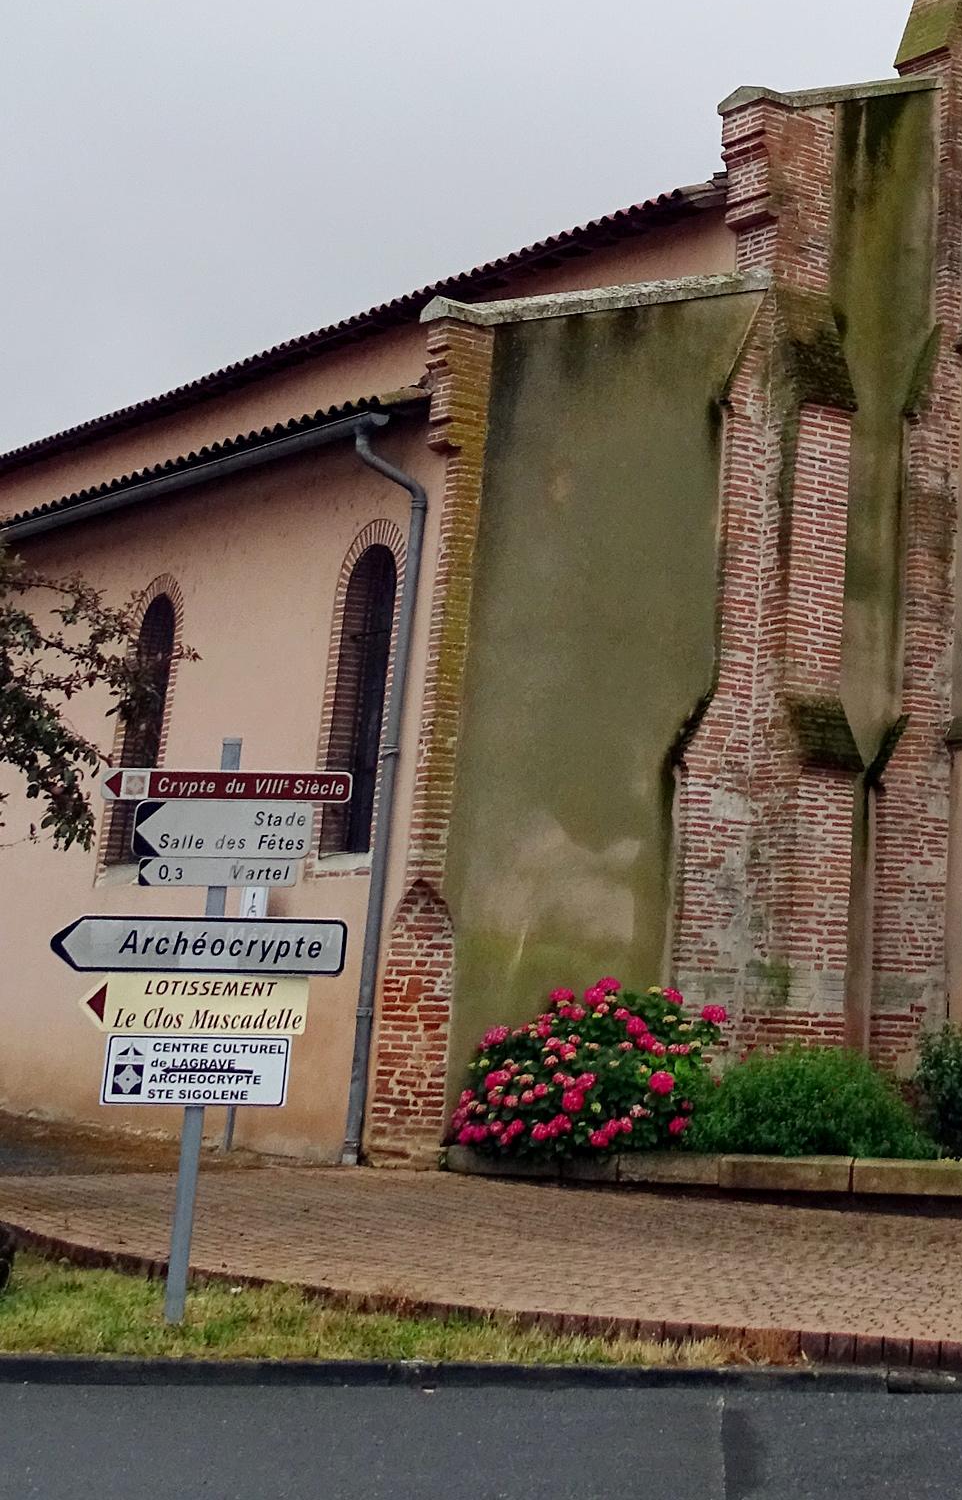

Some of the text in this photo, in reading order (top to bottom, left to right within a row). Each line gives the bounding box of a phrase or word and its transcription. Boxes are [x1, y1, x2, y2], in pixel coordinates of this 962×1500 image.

[158, 778, 215, 796] Crypte
[226, 780, 244, 793] du
[294, 780, 344, 796] Siècle
[255, 812, 306, 827] Stade
[159, 834, 304, 851] Salle des Fêtes
[119, 930, 322, 963] Archéocrypte
[145, 980, 277, 996] LOTISSEMENT
[114, 1008, 302, 1030] Le Clos Muscadelle
[153, 1043, 284, 1054] CENTRE CULTUREL
[151, 1059, 236, 1069] de LAGRAVE
[149, 1074, 261, 1085] ARCHEOCRYPTE
[148, 1089, 248, 1100] STE SIGOLENE
